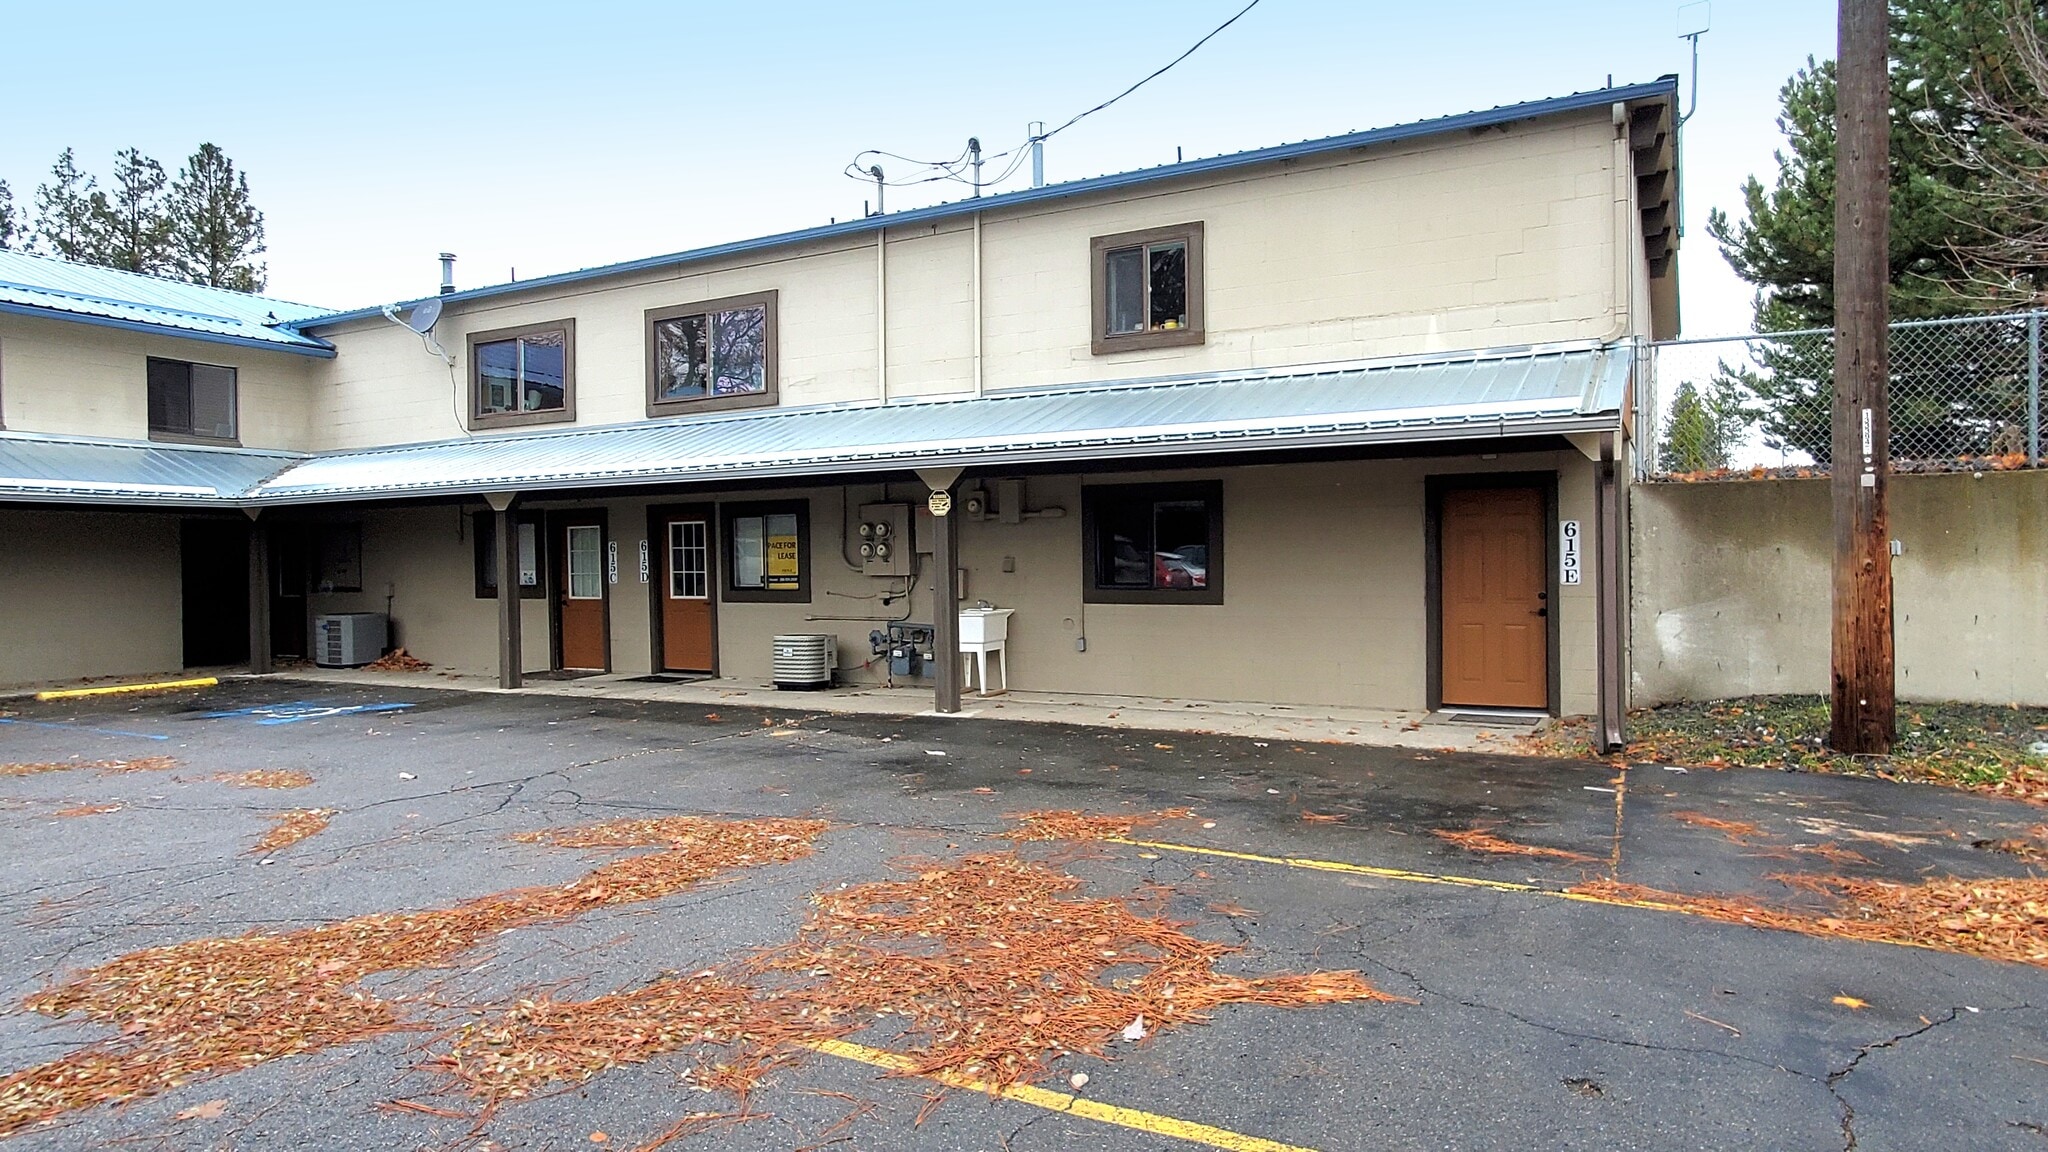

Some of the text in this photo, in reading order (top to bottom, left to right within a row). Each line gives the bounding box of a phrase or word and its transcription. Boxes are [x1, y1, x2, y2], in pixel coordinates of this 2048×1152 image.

[609, 542, 617, 583] 615C
[640, 540, 649, 582] 615D
[767, 541, 796, 549] PACE FOR
[777, 552, 796, 560] LEASE
[1564, 521, 1578, 584] 615E
